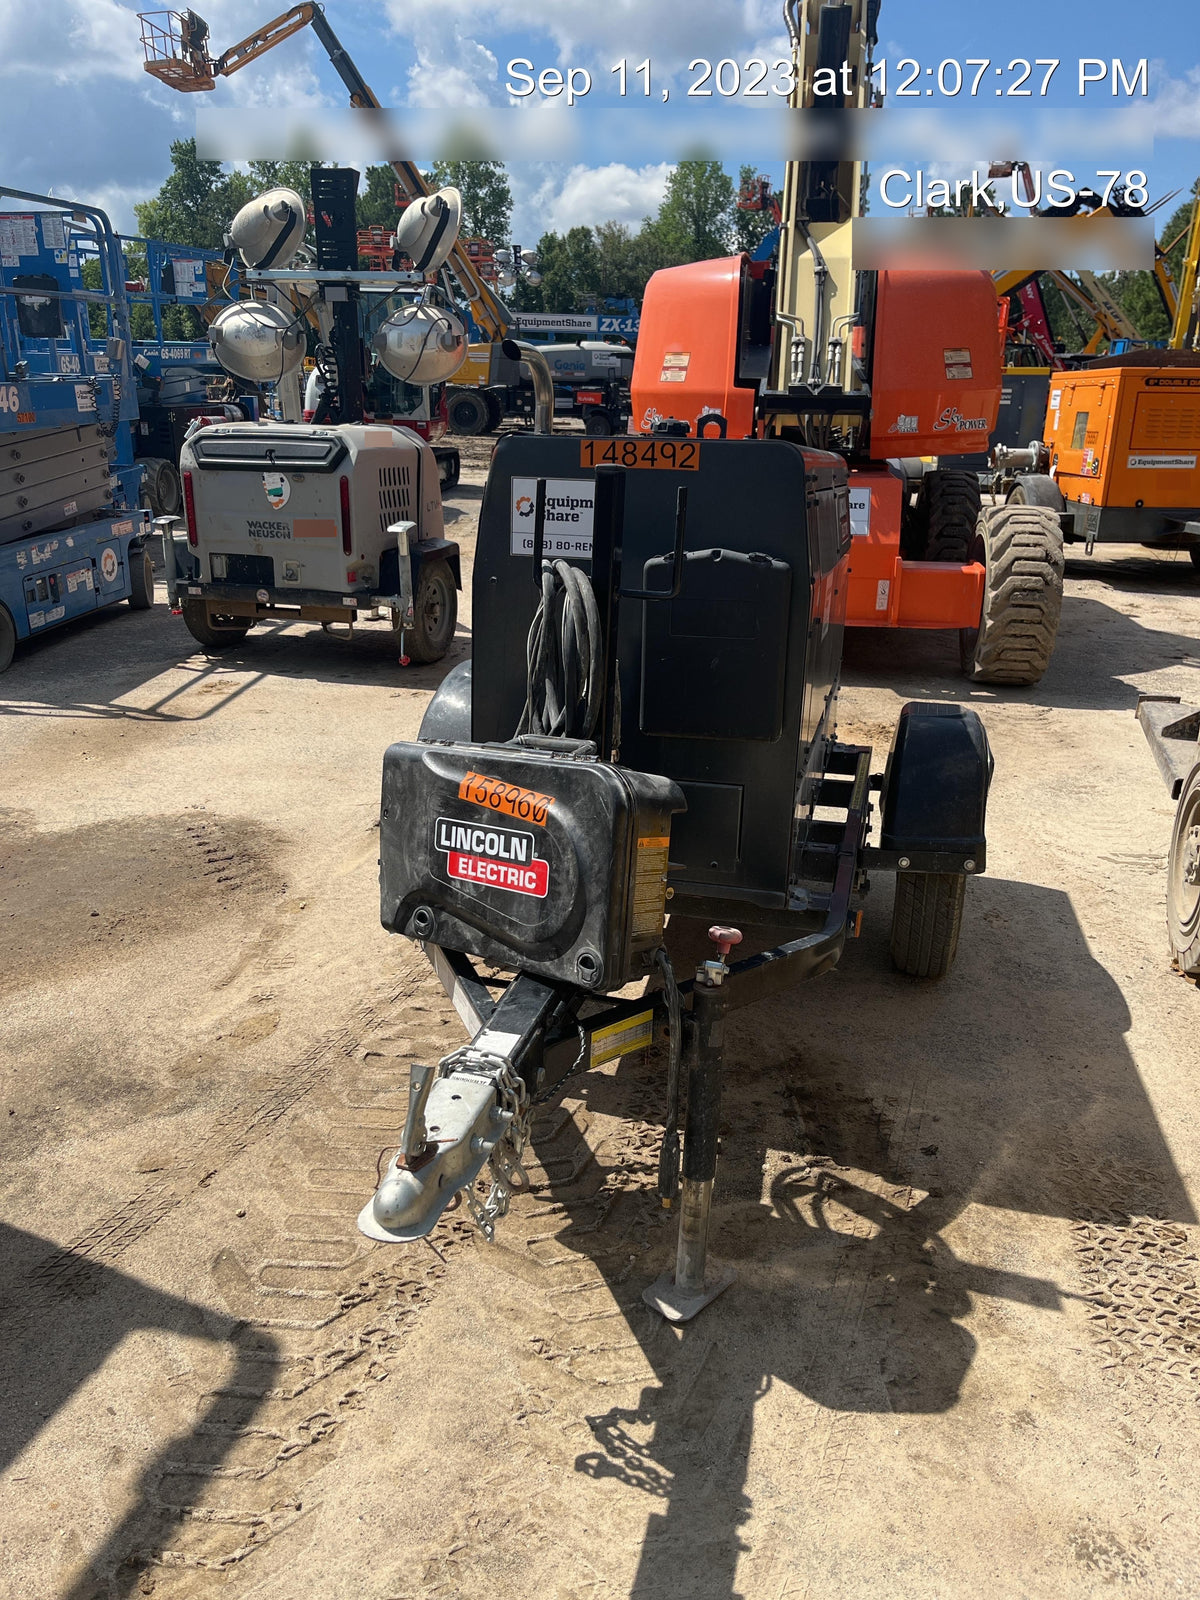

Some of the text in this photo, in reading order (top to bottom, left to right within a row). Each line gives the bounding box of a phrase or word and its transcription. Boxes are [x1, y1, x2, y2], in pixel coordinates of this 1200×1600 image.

[516, 317, 592, 328] EquipmentShare
[554, 360, 586, 371] Genie
[934, 408, 963, 430] Sky
[956, 418, 988, 432] POWER
[584, 441, 696, 469] 148492
[1137, 459, 1195, 467] EquipmentShare
[247, 521, 290, 531] WACKER
[248, 529, 291, 539] NEUSON
[463, 775, 549, 824] 158960
[440, 824, 527, 862] LINCOLN
[458, 857, 537, 890] ELECTRIC
